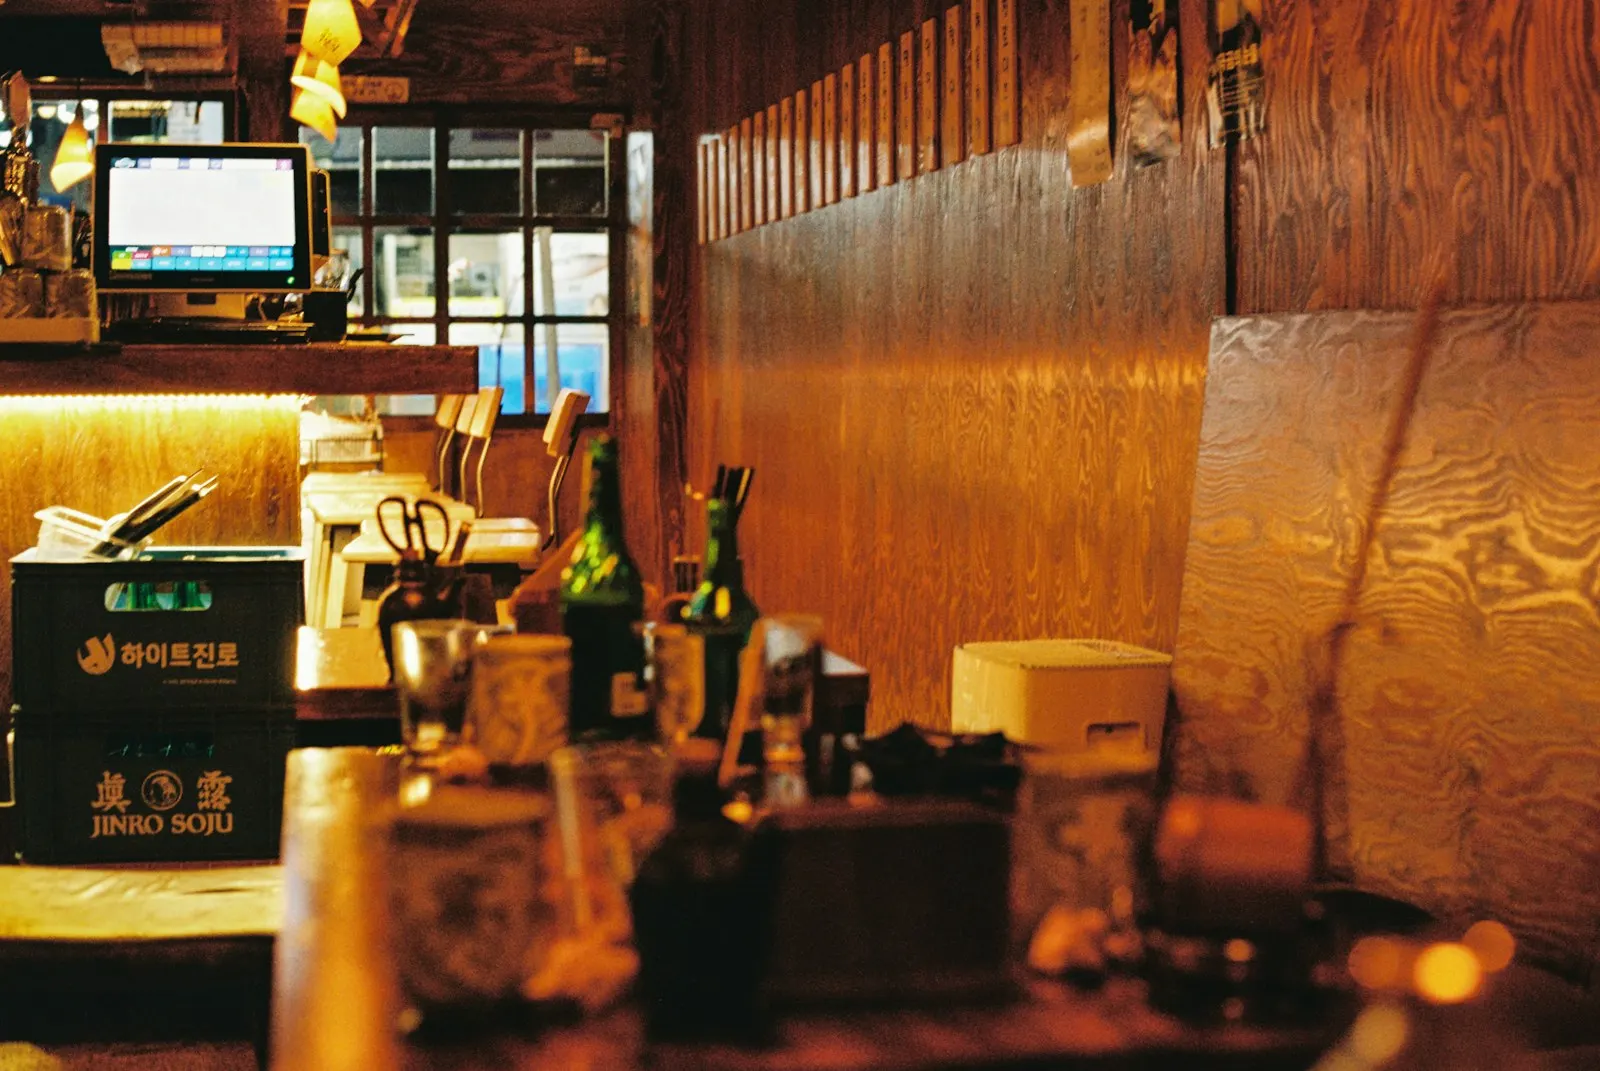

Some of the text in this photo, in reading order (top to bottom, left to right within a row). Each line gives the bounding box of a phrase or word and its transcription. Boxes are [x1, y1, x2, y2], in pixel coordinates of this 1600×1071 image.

[120, 642, 240, 669] 하이트진로
[90, 812, 234, 839] JINRO SOJU
